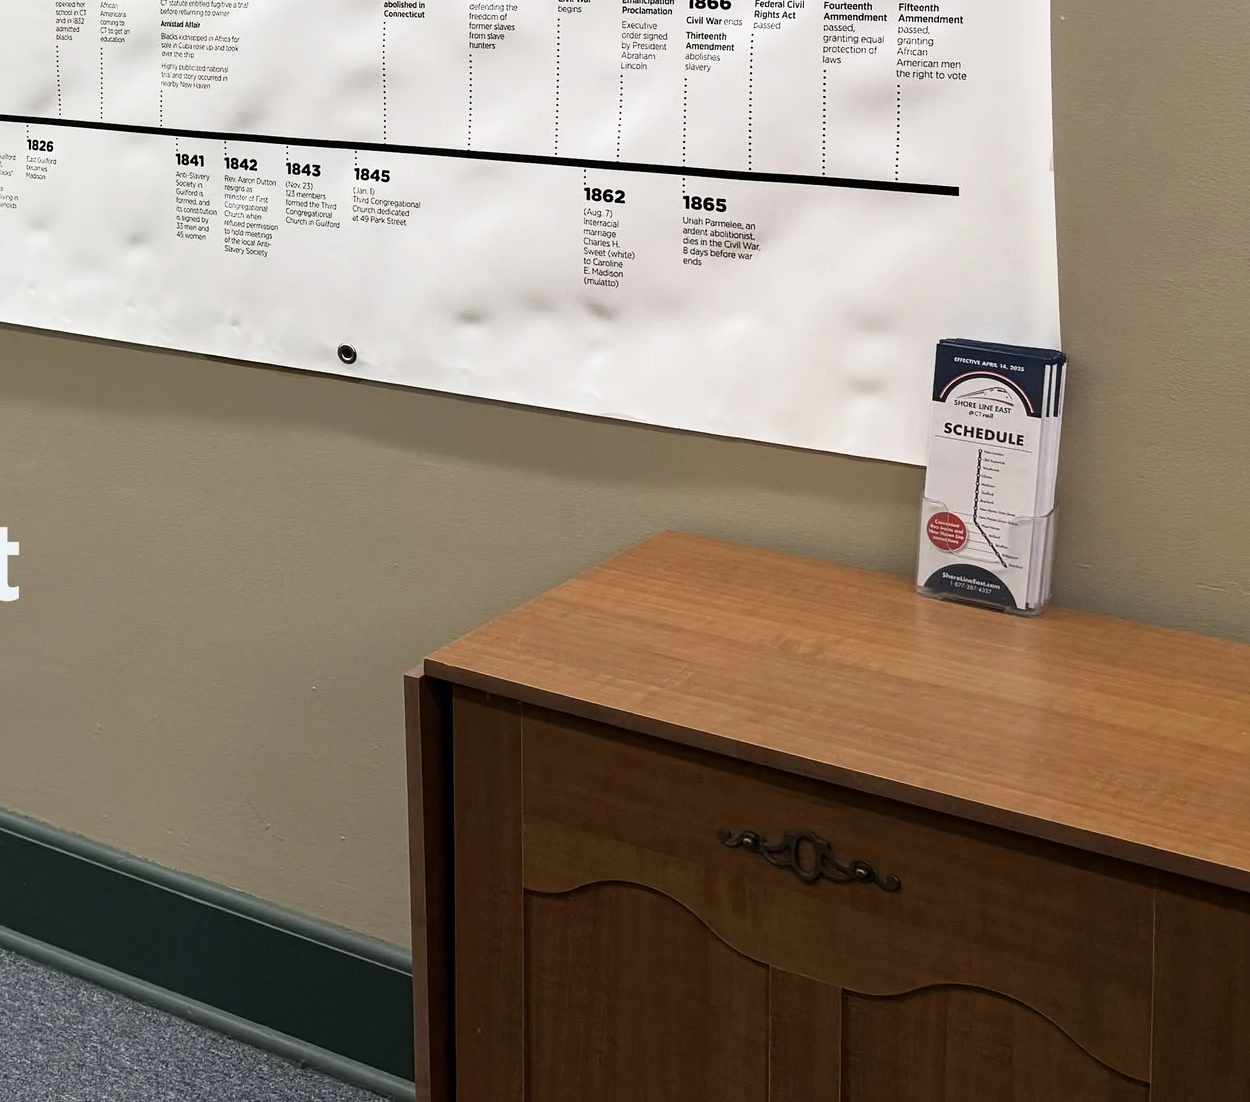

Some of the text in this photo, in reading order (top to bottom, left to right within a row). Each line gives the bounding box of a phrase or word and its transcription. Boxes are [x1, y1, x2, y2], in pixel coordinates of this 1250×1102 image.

[384, 1, 425, 9] abolished in
[755, 0, 805, 8] Federal Civil
[824, 1, 872, 10] Fourteenth
[899, 3, 939, 12] Fifteenth
[384, 10, 425, 18] Connecticut
[558, 5, 582, 14] begins
[622, 6, 673, 15] Proclamation
[754, 10, 796, 20] Rights Act
[823, 12, 887, 22] Ammendment
[898, 14, 963, 24] Ammendment
[686, 16, 703, 24] Civil
[706, 17, 722, 25] War
[823, 24, 855, 32] passed,
[686, 31, 727, 40] Thirteenth
[823, 35, 884, 44] granting equal
[686, 42, 734, 51] Amendment
[897, 38, 934, 47] granting
[823, 45, 877, 54] protection of
[897, 47, 928, 56] African
[685, 53, 720, 61] abolishes
[822, 55, 841, 64] laws
[685, 63, 711, 73] slavery
[896, 58, 961, 69] American men
[896, 70, 967, 80] the right to vote
[27, 139, 53, 152] 1826
[175, 153, 204, 167] 1841
[224, 157, 258, 171] 1842
[286, 162, 321, 177] 1843
[354, 168, 390, 183] 1845
[584, 187, 625, 204] 1862
[683, 195, 727, 212] 1865
[954, 357, 980, 365] EFFECTIVE
[954, 399, 1012, 414] SHORE LINE EAST
[944, 422, 1024, 446] SCHEDULE
